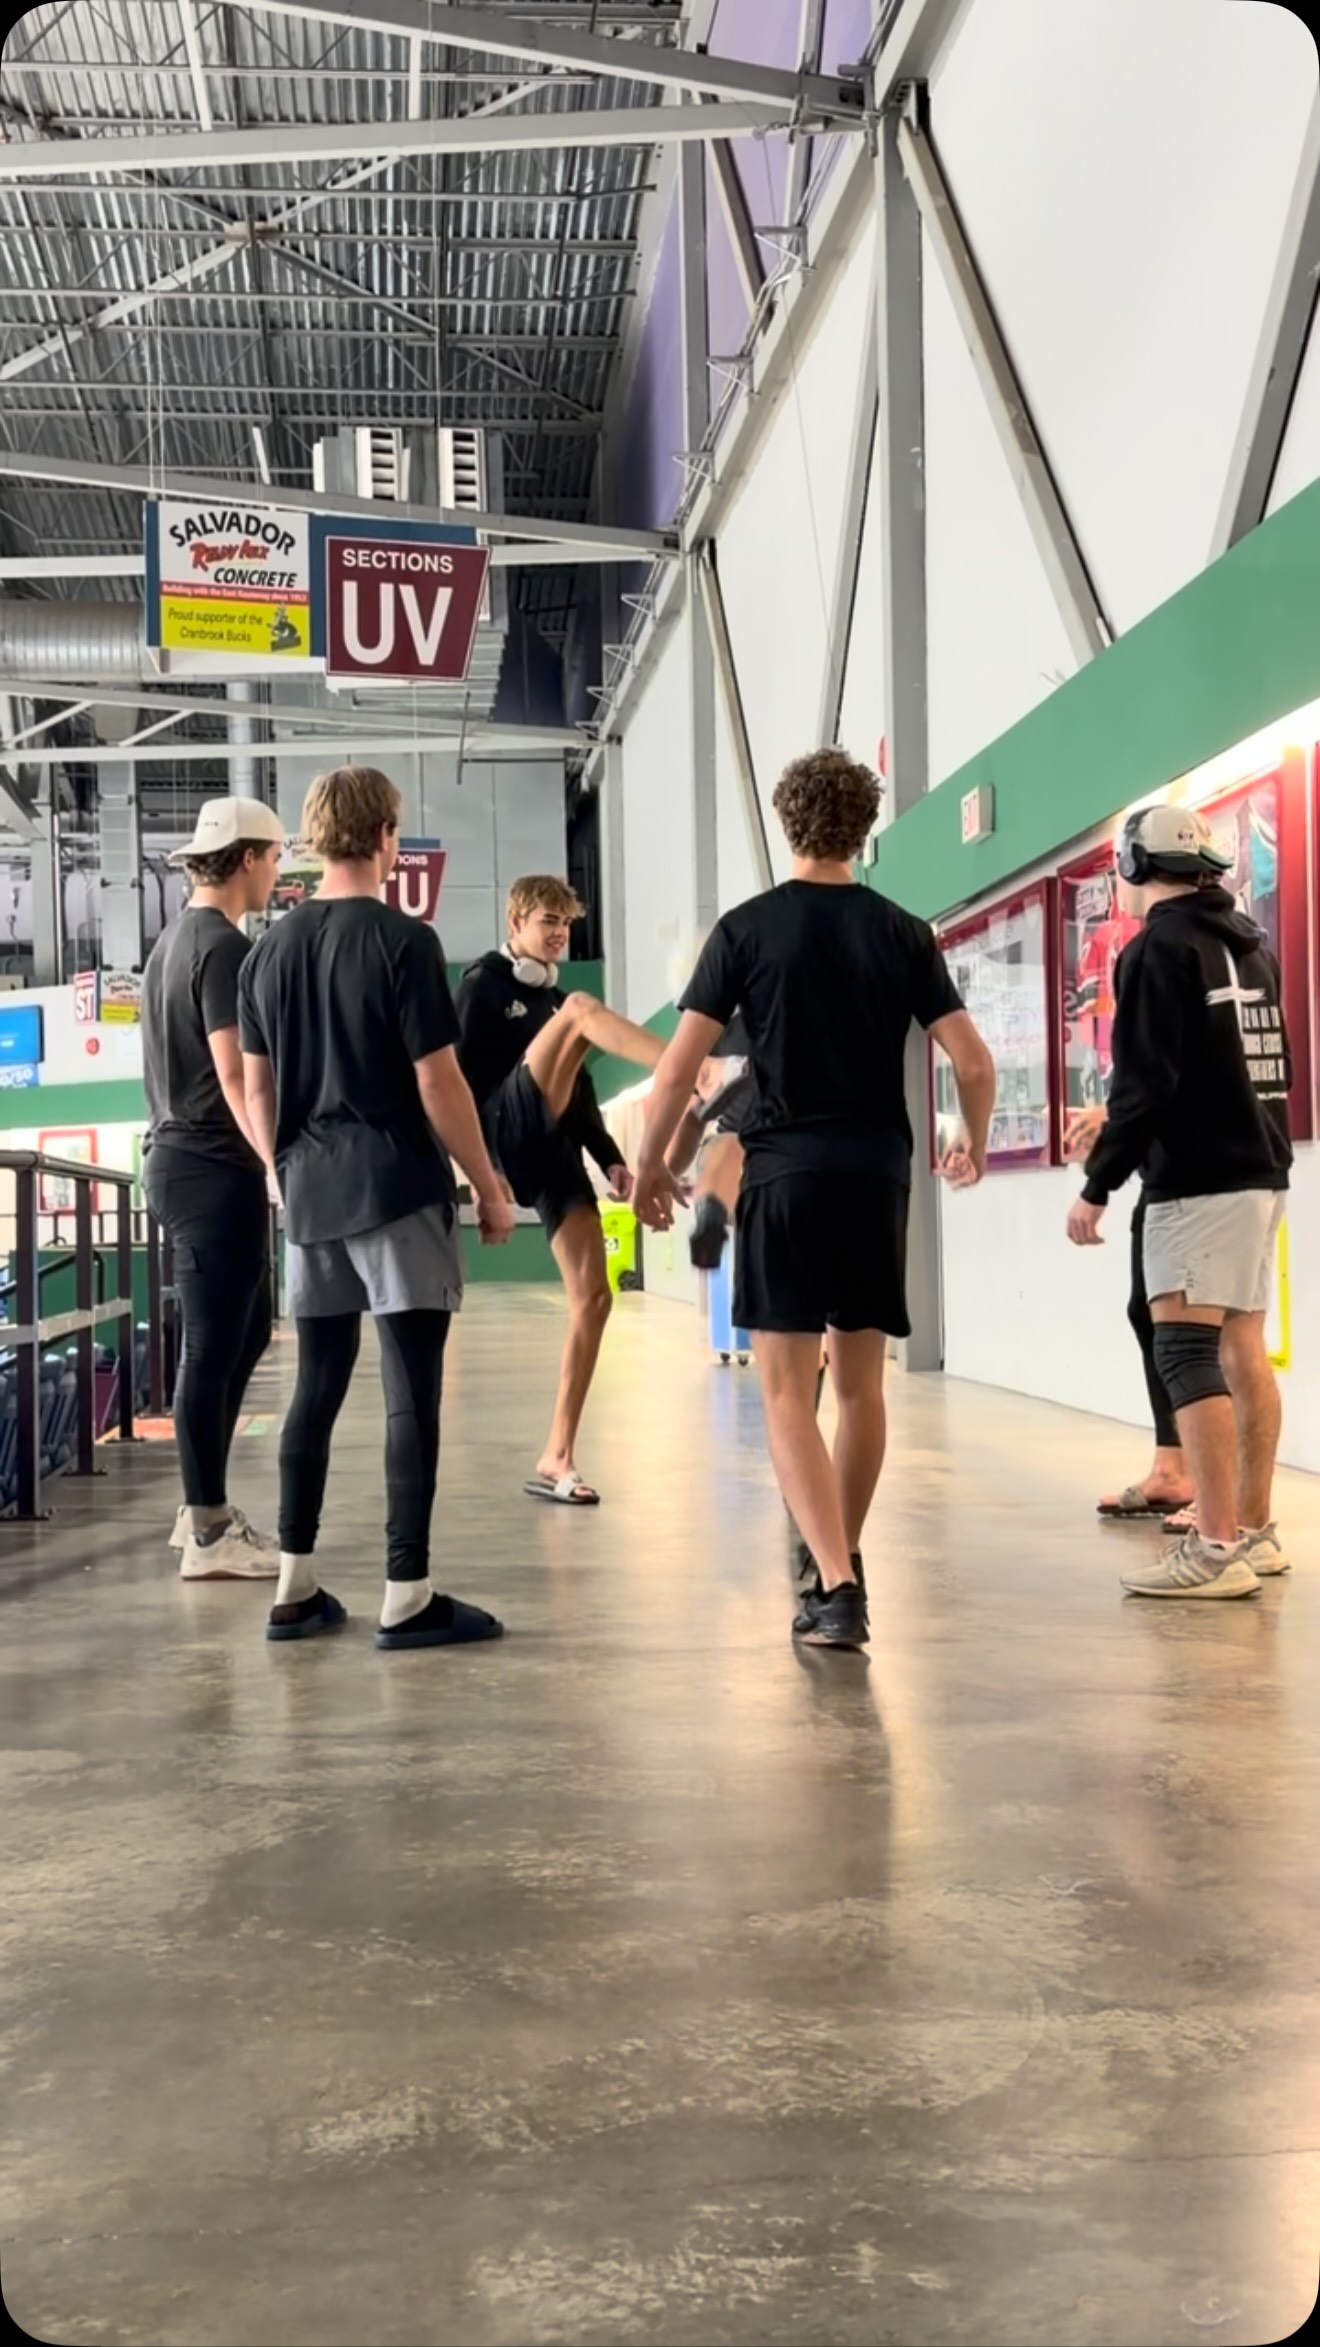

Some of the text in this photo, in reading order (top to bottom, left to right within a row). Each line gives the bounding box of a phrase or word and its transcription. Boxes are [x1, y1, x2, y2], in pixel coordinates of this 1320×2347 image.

[169, 511, 296, 555] SALVADOR
[342, 549, 454, 574] SECTIONS
[214, 567, 298, 588] CONCRETE
[168, 607, 263, 625] Proud supporter of the
[342, 580, 454, 667] UV
[180, 626, 251, 642] Cranbrook Bucks
[398, 854, 429, 866] IONS
[75, 988, 94, 1022] ST
